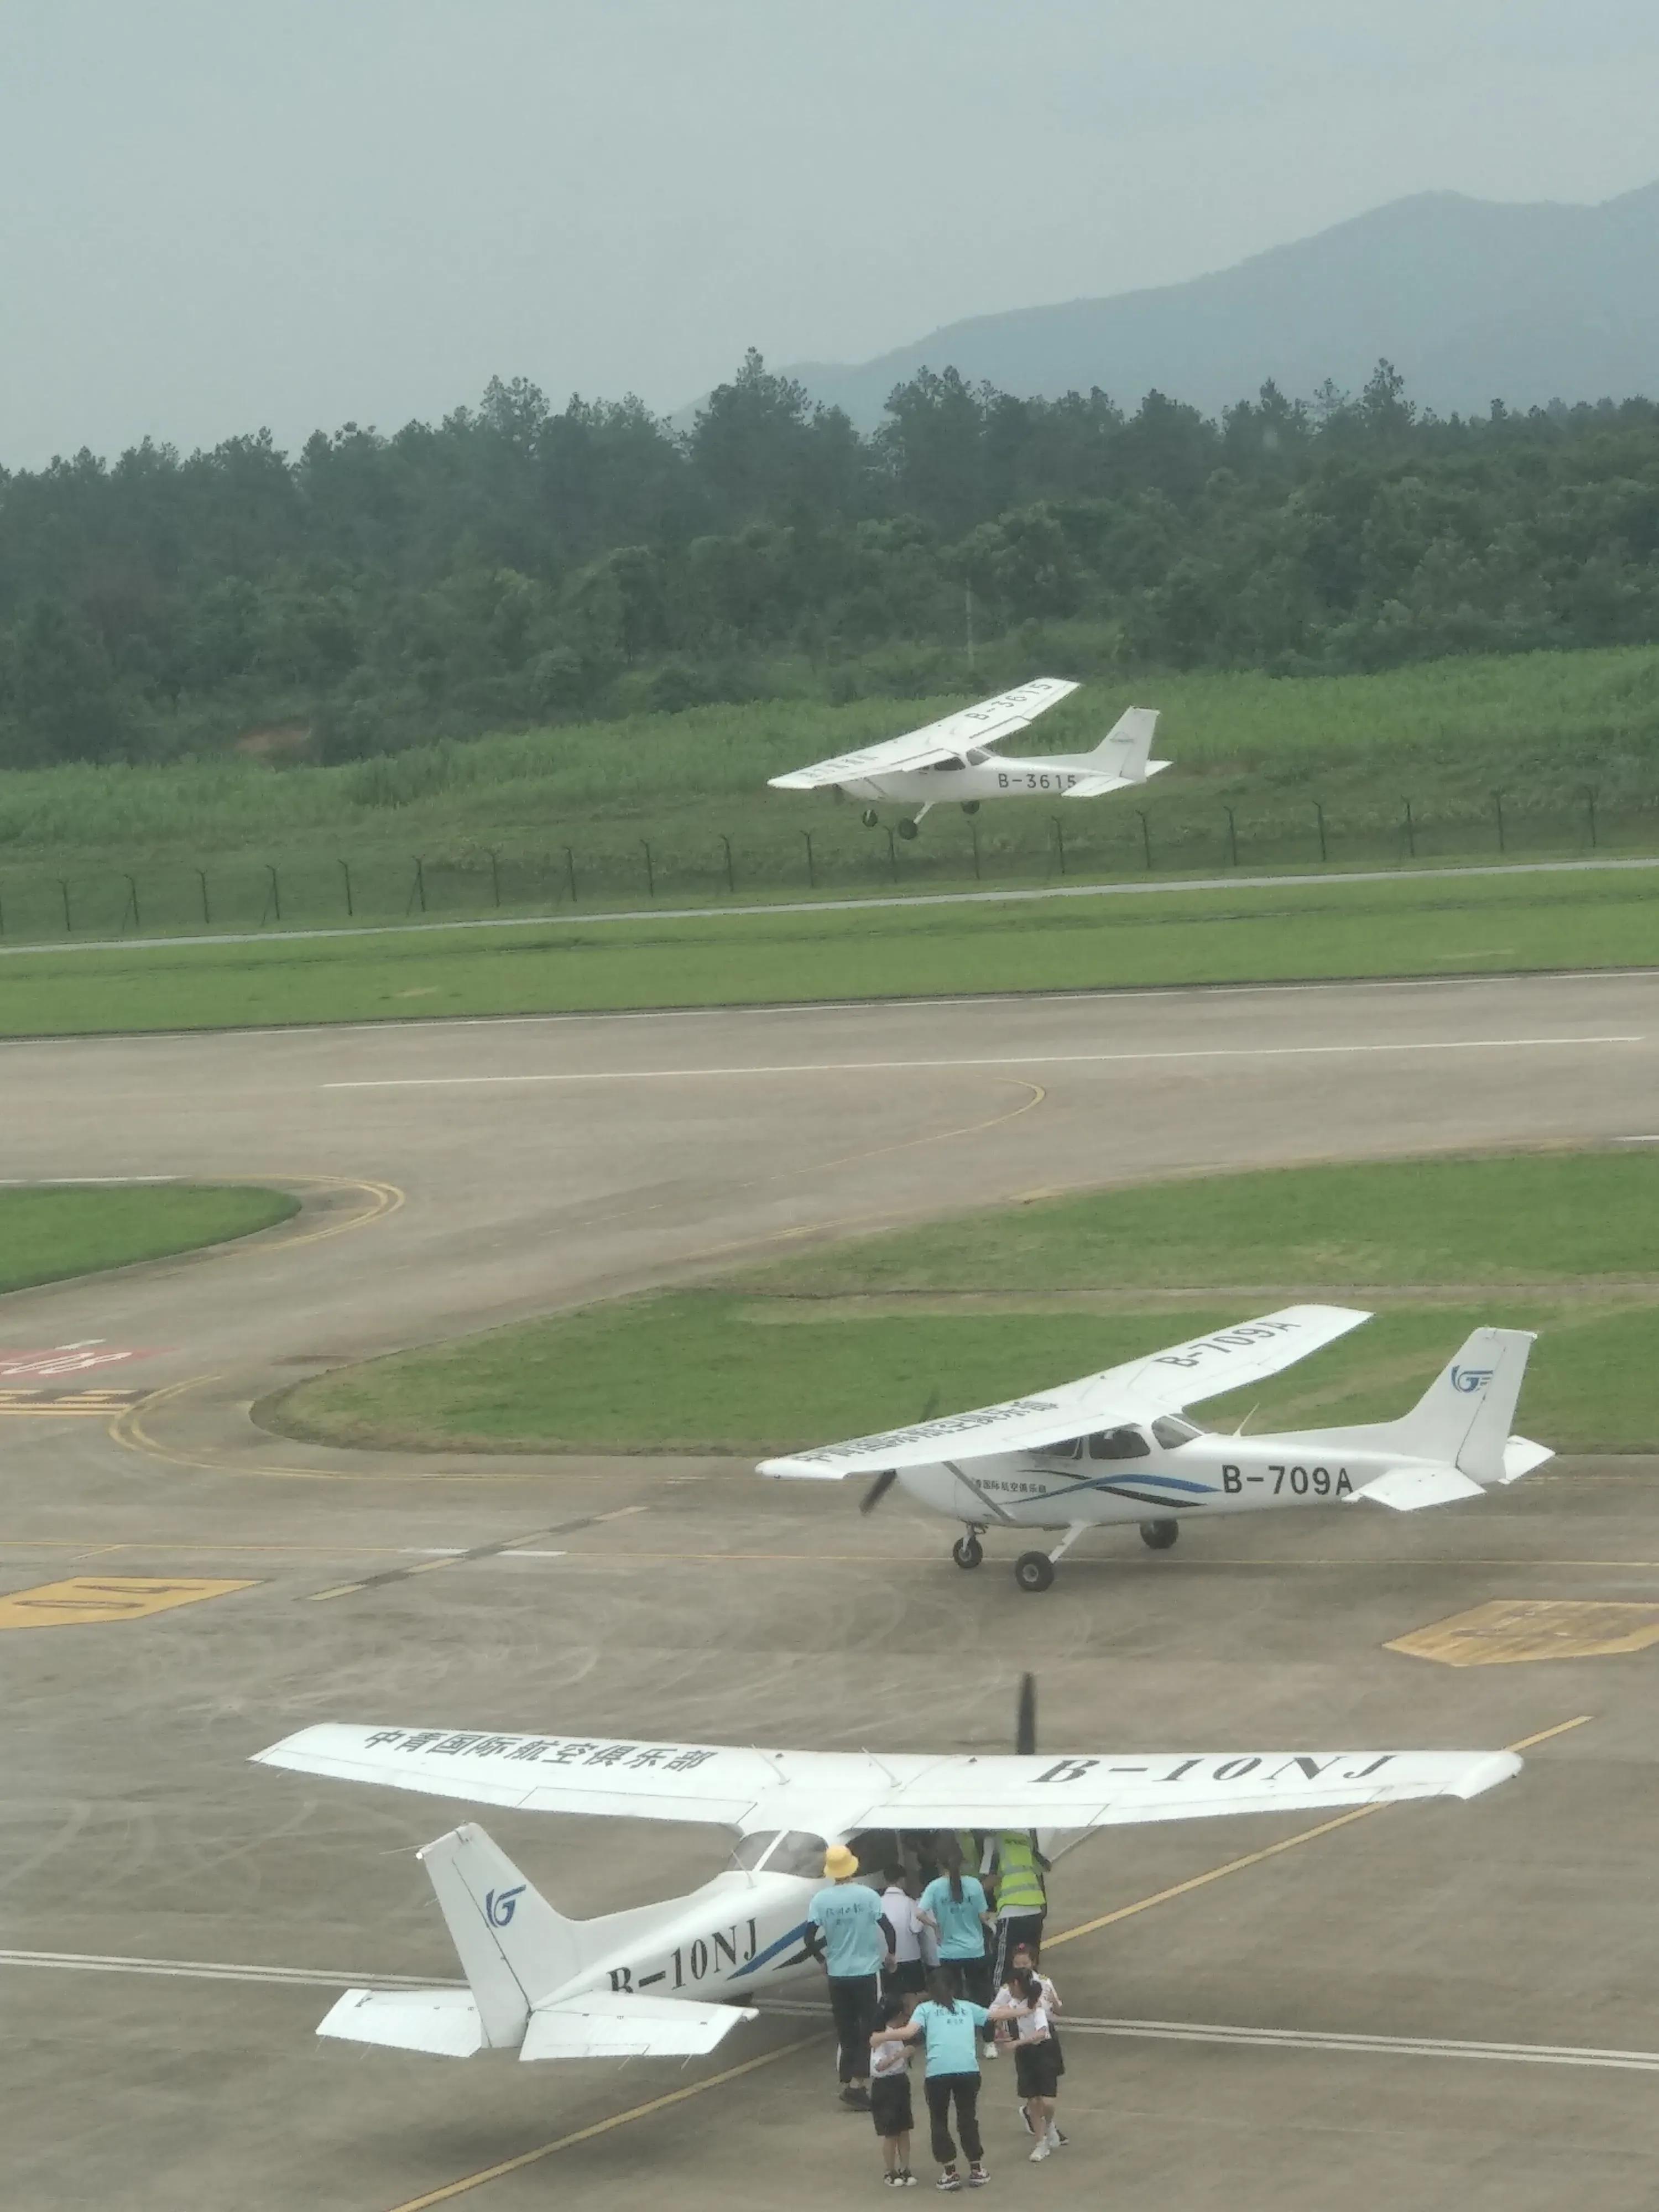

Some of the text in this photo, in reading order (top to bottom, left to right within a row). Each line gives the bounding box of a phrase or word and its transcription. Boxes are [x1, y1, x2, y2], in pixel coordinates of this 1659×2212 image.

[964, 684, 1052, 720] B-3615
[998, 773, 1077, 789] B-3615
[1152, 1322, 1301, 1367] B-709A
[1222, 1464, 1353, 1495] B-709A
[364, 1730, 719, 1771] 中青国际航空俱乐部
[1027, 1754, 1398, 1783] B-10NJ
[606, 1917, 756, 1994] B-10NJ
